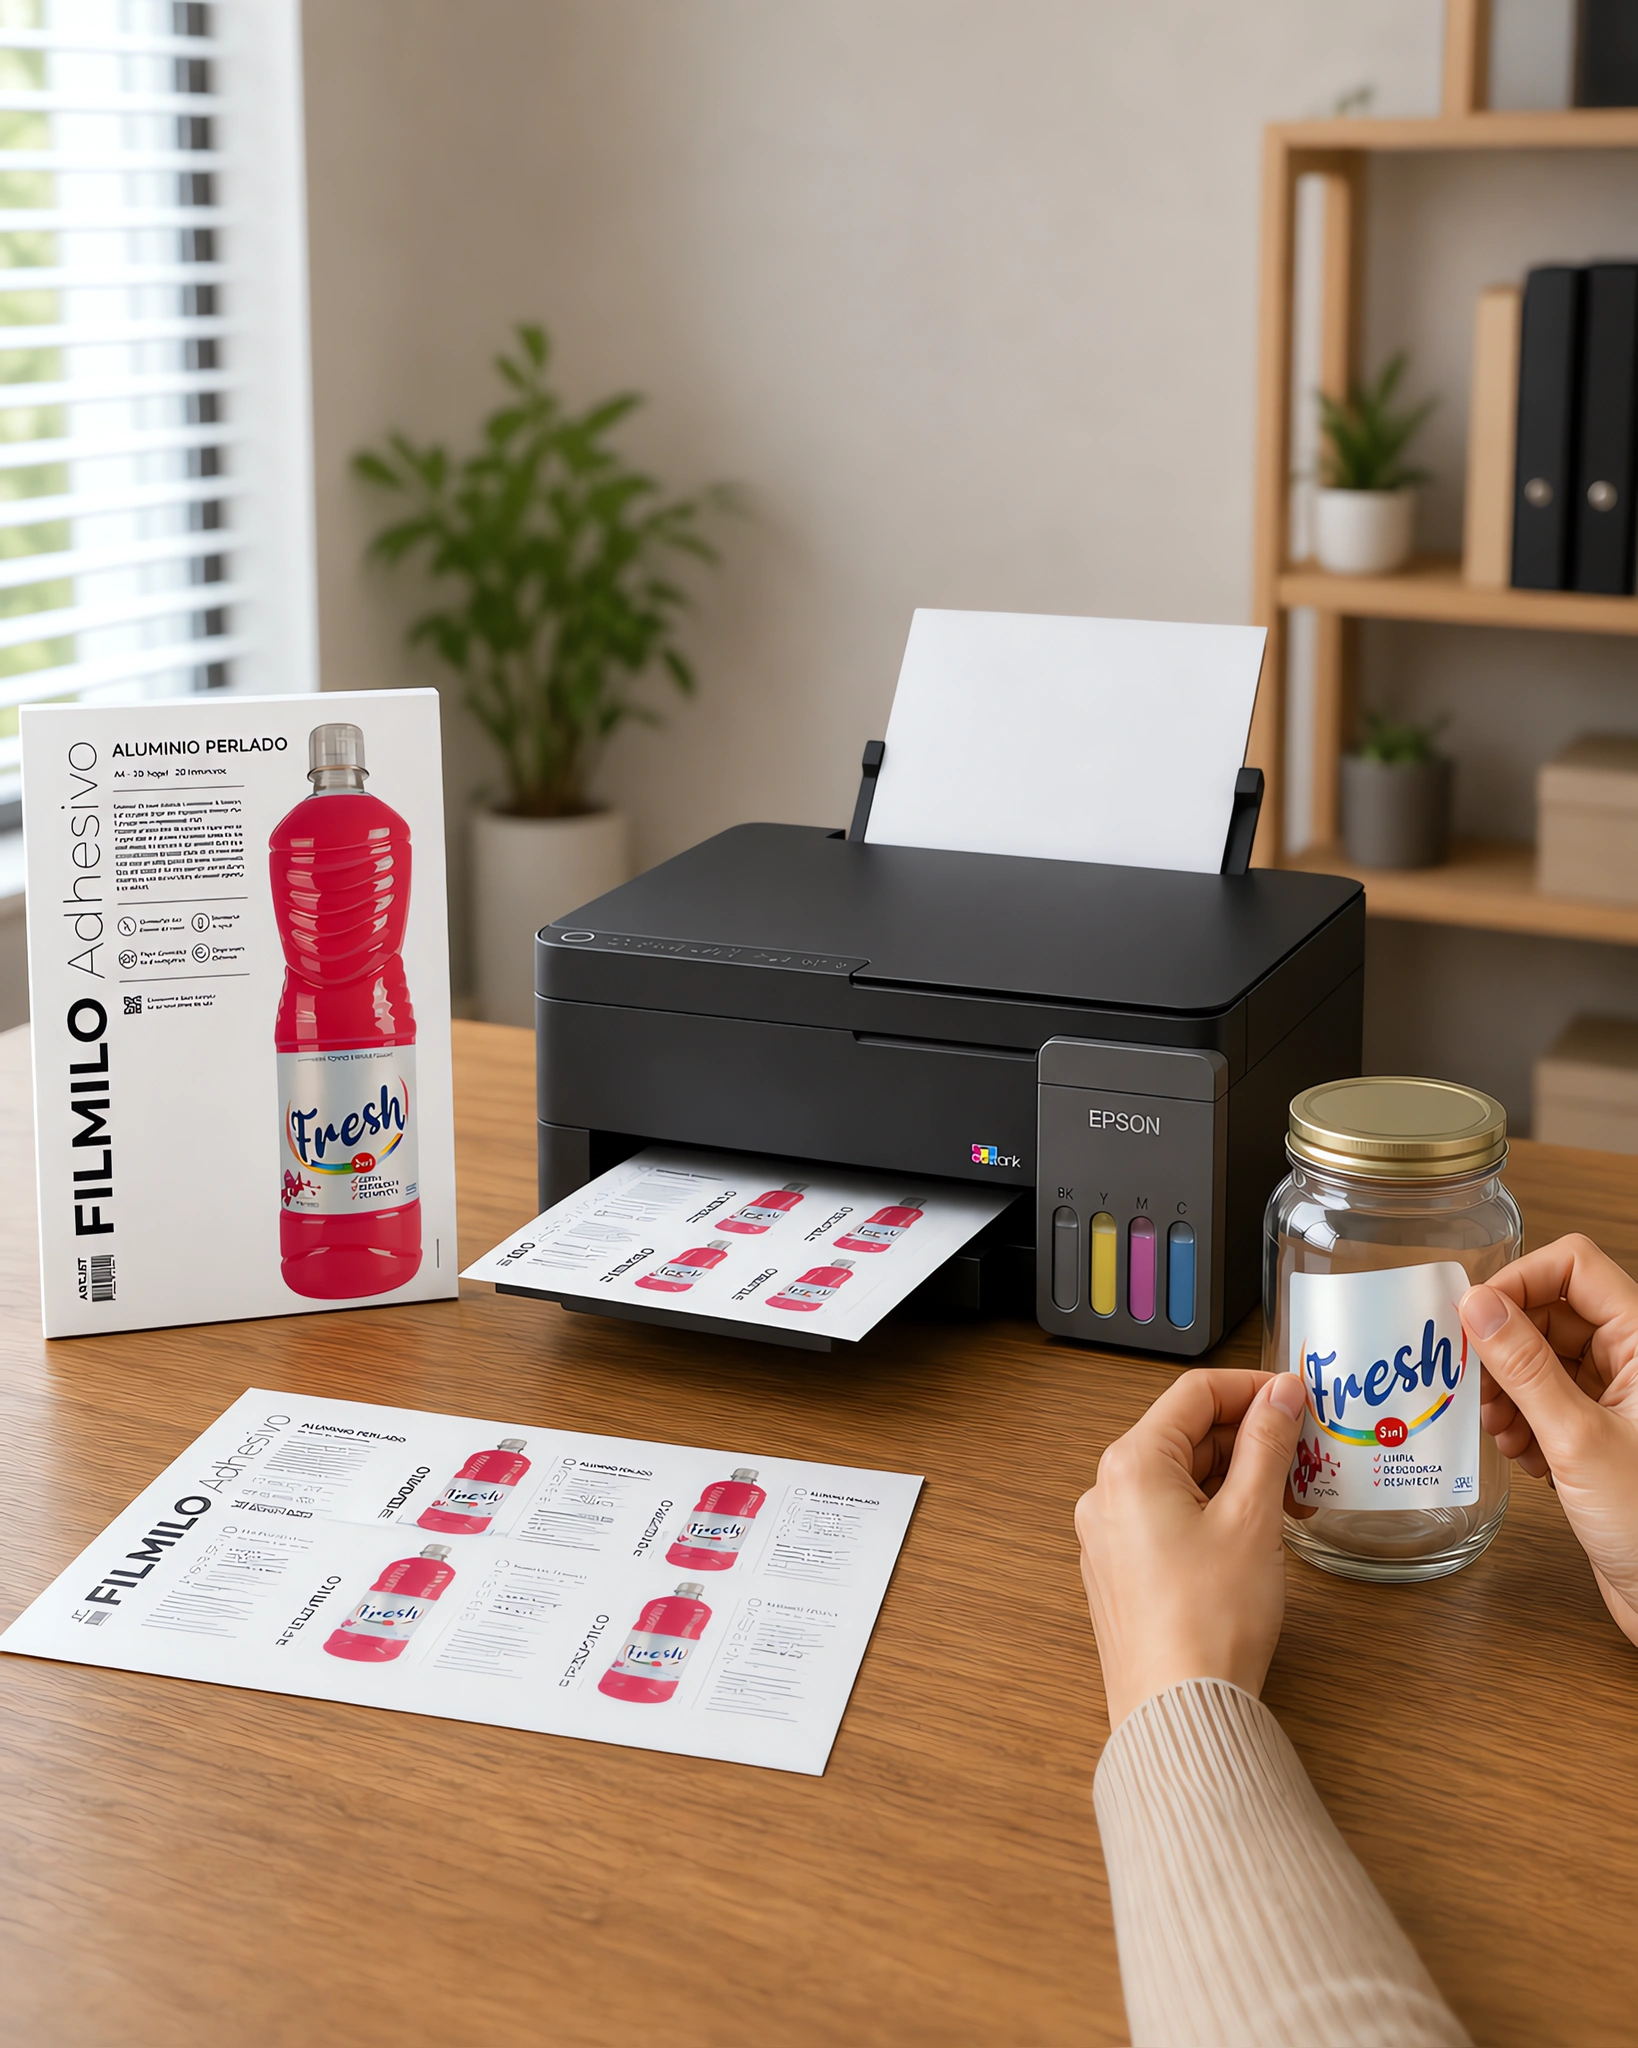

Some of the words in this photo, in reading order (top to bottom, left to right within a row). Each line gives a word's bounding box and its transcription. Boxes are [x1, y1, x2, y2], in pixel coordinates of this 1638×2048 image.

[112, 740, 200, 758] ALUMINIO
[206, 737, 288, 754] PERLADO
[62, 741, 105, 979] Adhesivo
[67, 997, 115, 1236] FILMILO
[291, 1085, 406, 1163] Fresh
[1089, 1109, 1160, 1135] EPSON
[1100, 1192, 1108, 1205] Y
[1136, 1197, 1148, 1210] M
[1176, 1201, 1187, 1215] C
[1306, 1319, 1461, 1423] Fresh
[84, 1495, 212, 1606] FILMILO
[199, 1414, 291, 1494] Adhesivo
